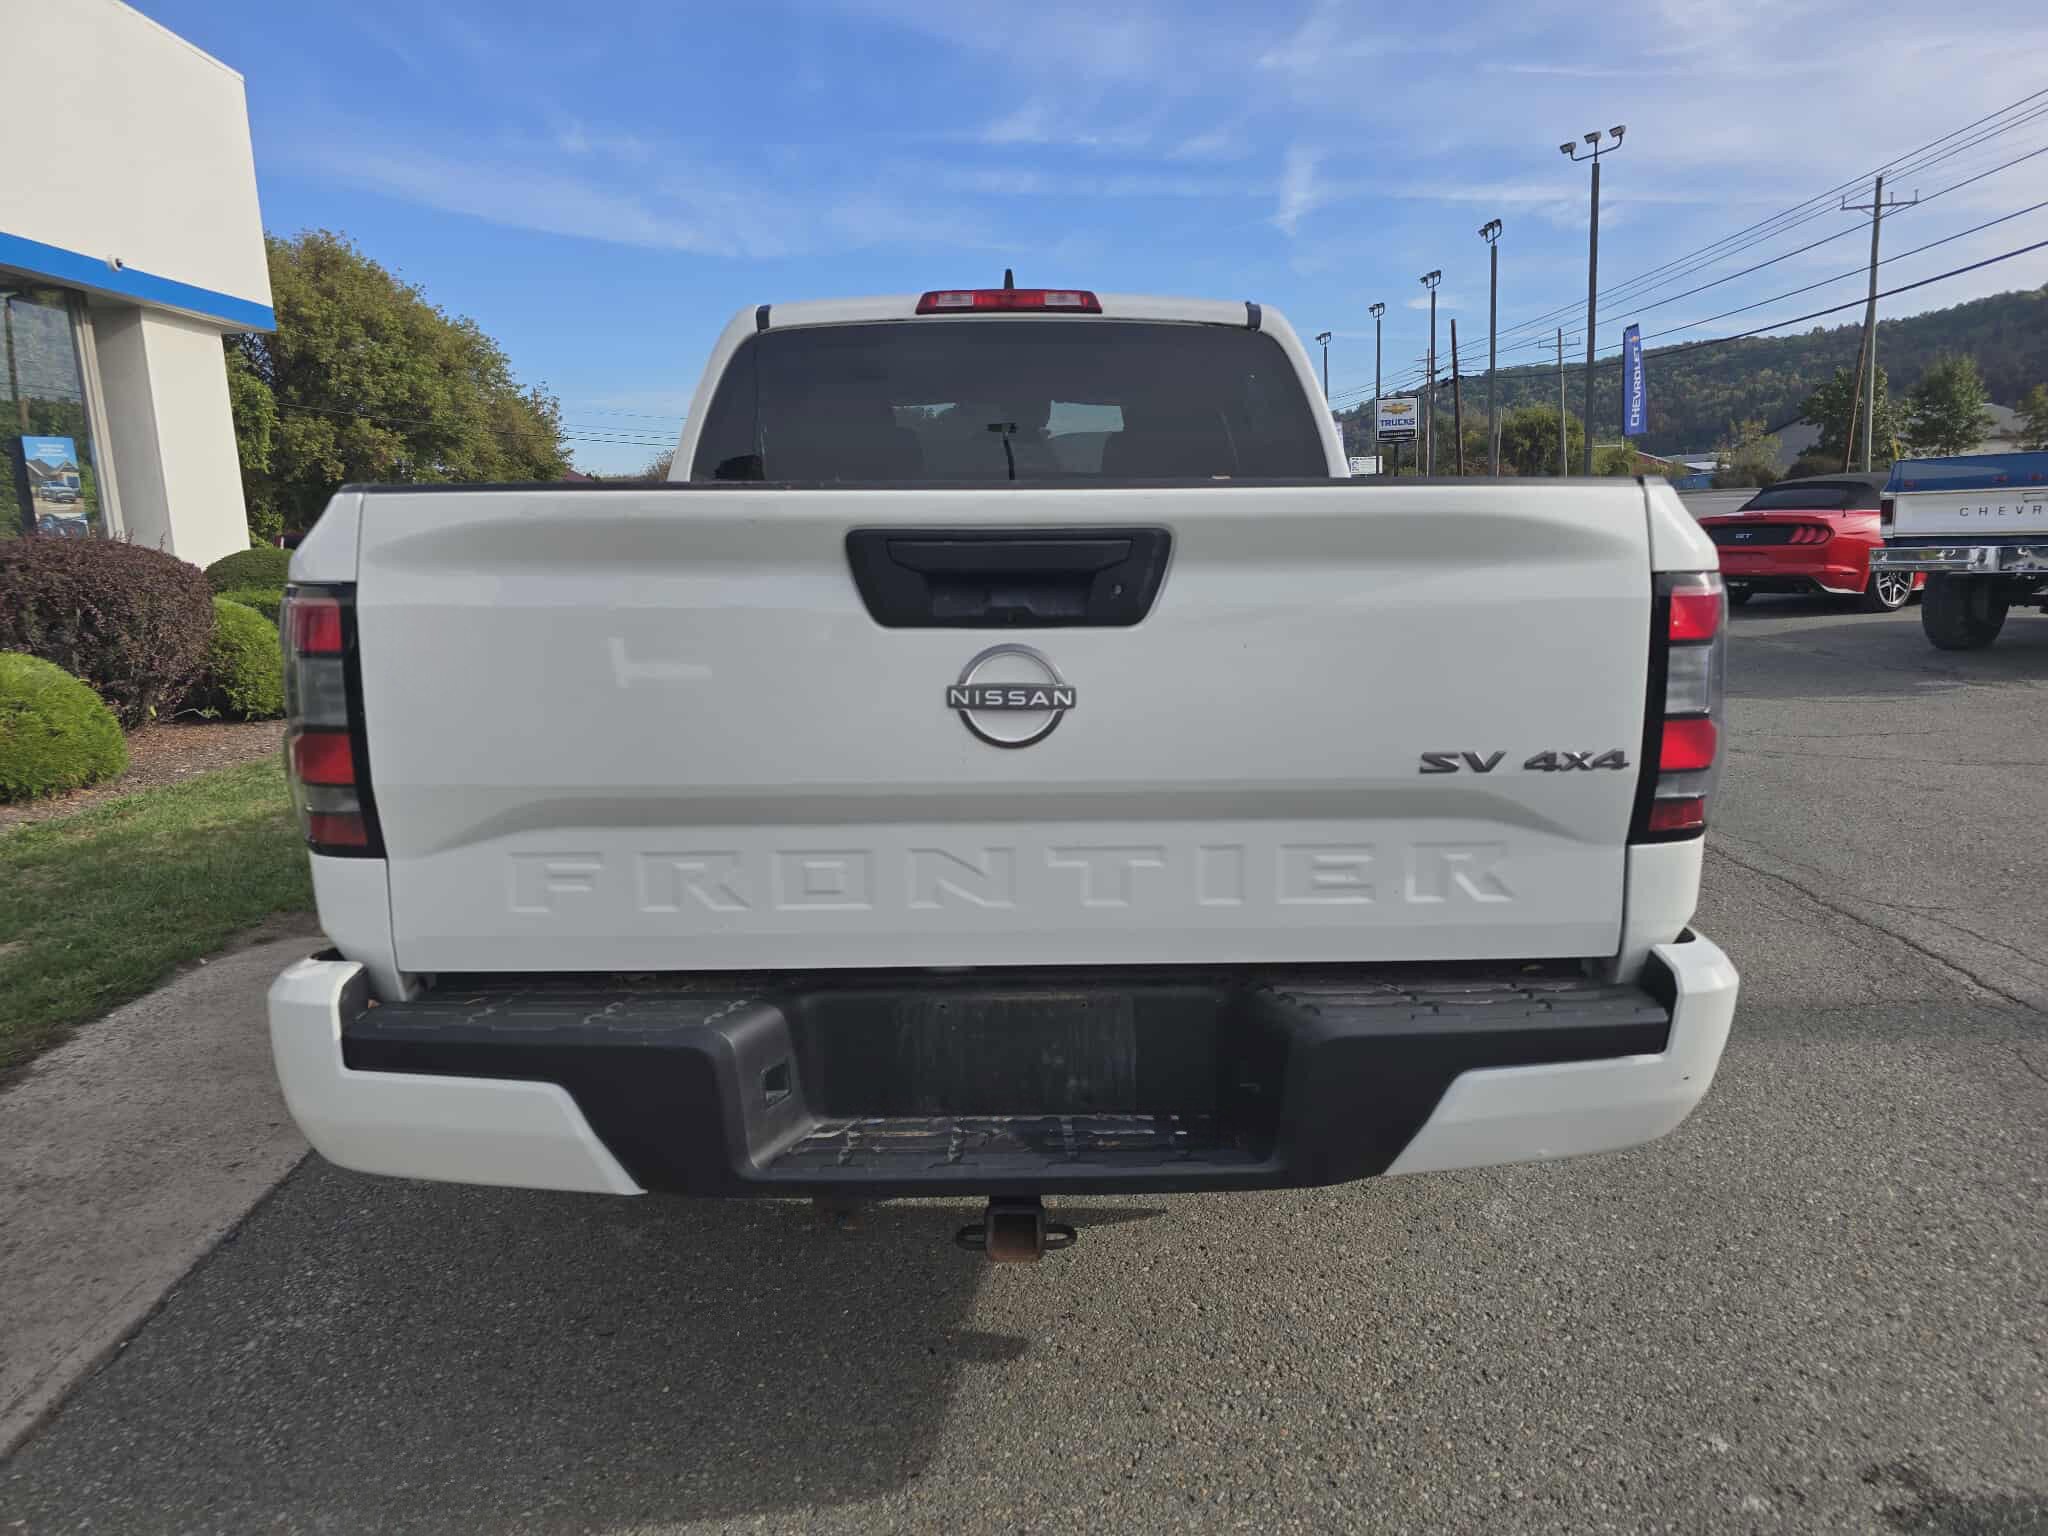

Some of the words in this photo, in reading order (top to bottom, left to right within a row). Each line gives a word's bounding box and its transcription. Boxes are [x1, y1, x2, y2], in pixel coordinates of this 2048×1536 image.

[1630, 346, 1641, 427] CHEVROLET
[1381, 418, 1415, 426] TRUCKS
[950, 689, 1073, 706] NISSAN
[1419, 751, 1506, 774] SV
[507, 840, 1513, 913] FRONTIER
